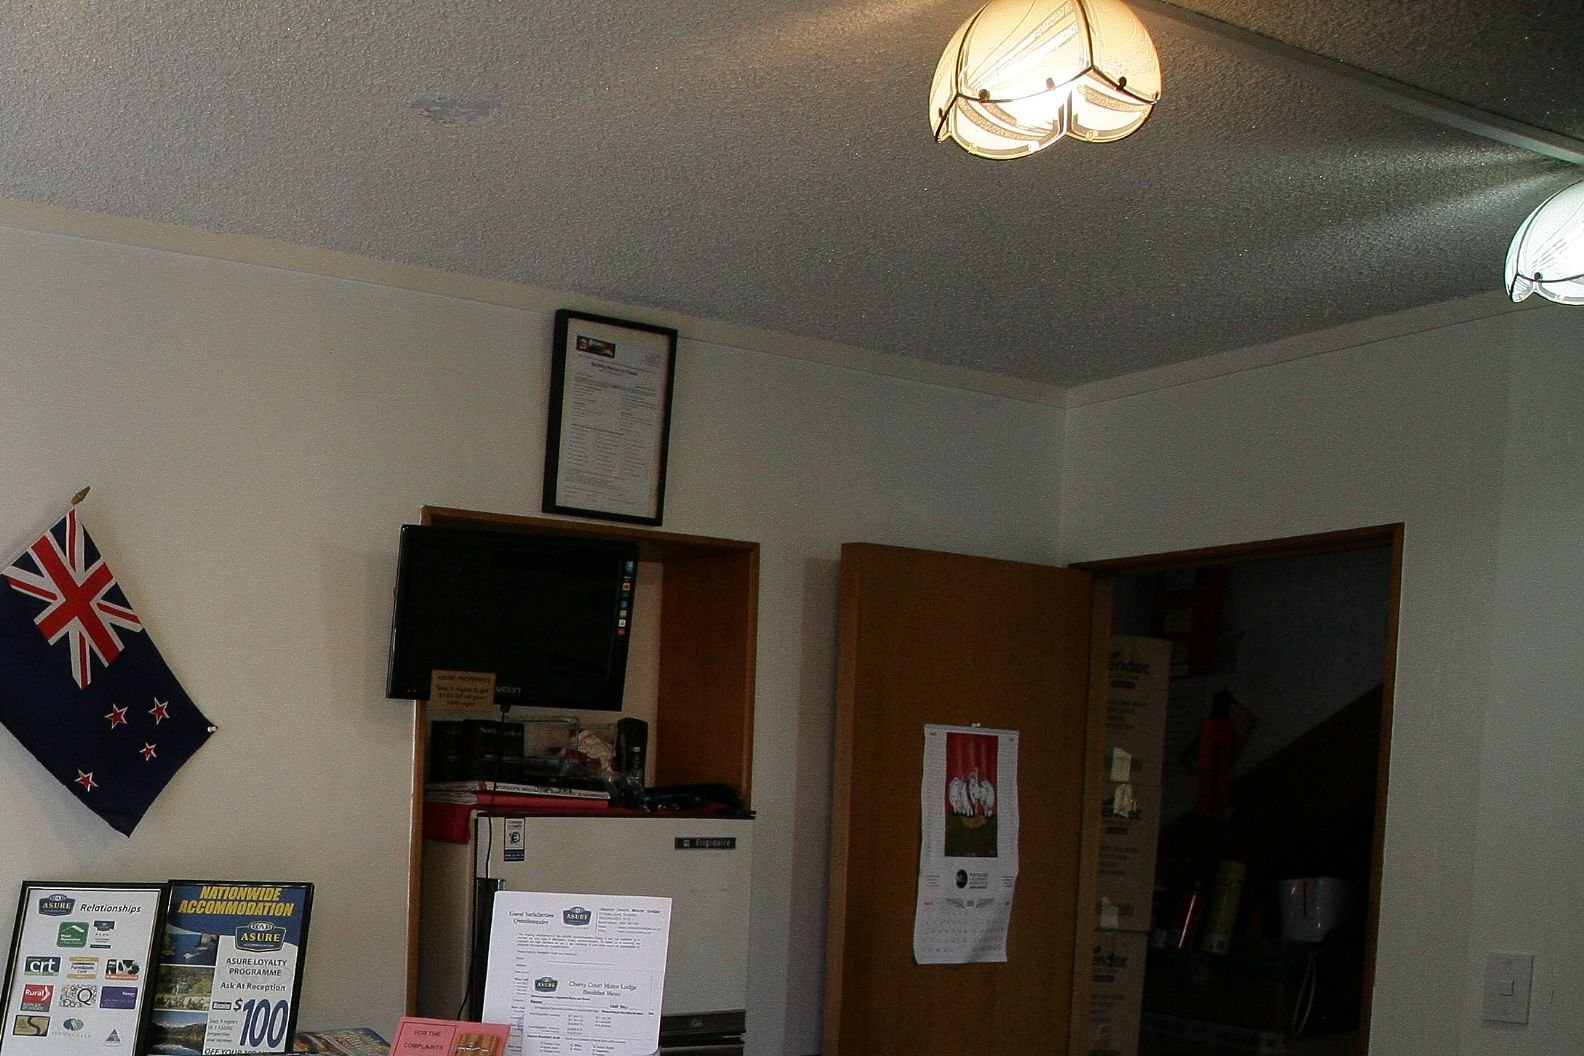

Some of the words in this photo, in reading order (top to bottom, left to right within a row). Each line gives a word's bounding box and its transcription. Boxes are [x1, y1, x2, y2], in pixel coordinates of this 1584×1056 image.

[200, 886, 281, 900] NATIONWIDE
[39, 901, 72, 910] ASURE
[80, 903, 141, 914] Relationships
[178, 900, 294, 917] ACCOMMODATION
[240, 931, 281, 942] ASURE
[30, 959, 55, 972] crt
[229, 968, 281, 976] PROGRAMME
[247, 984, 285, 992] Reception
